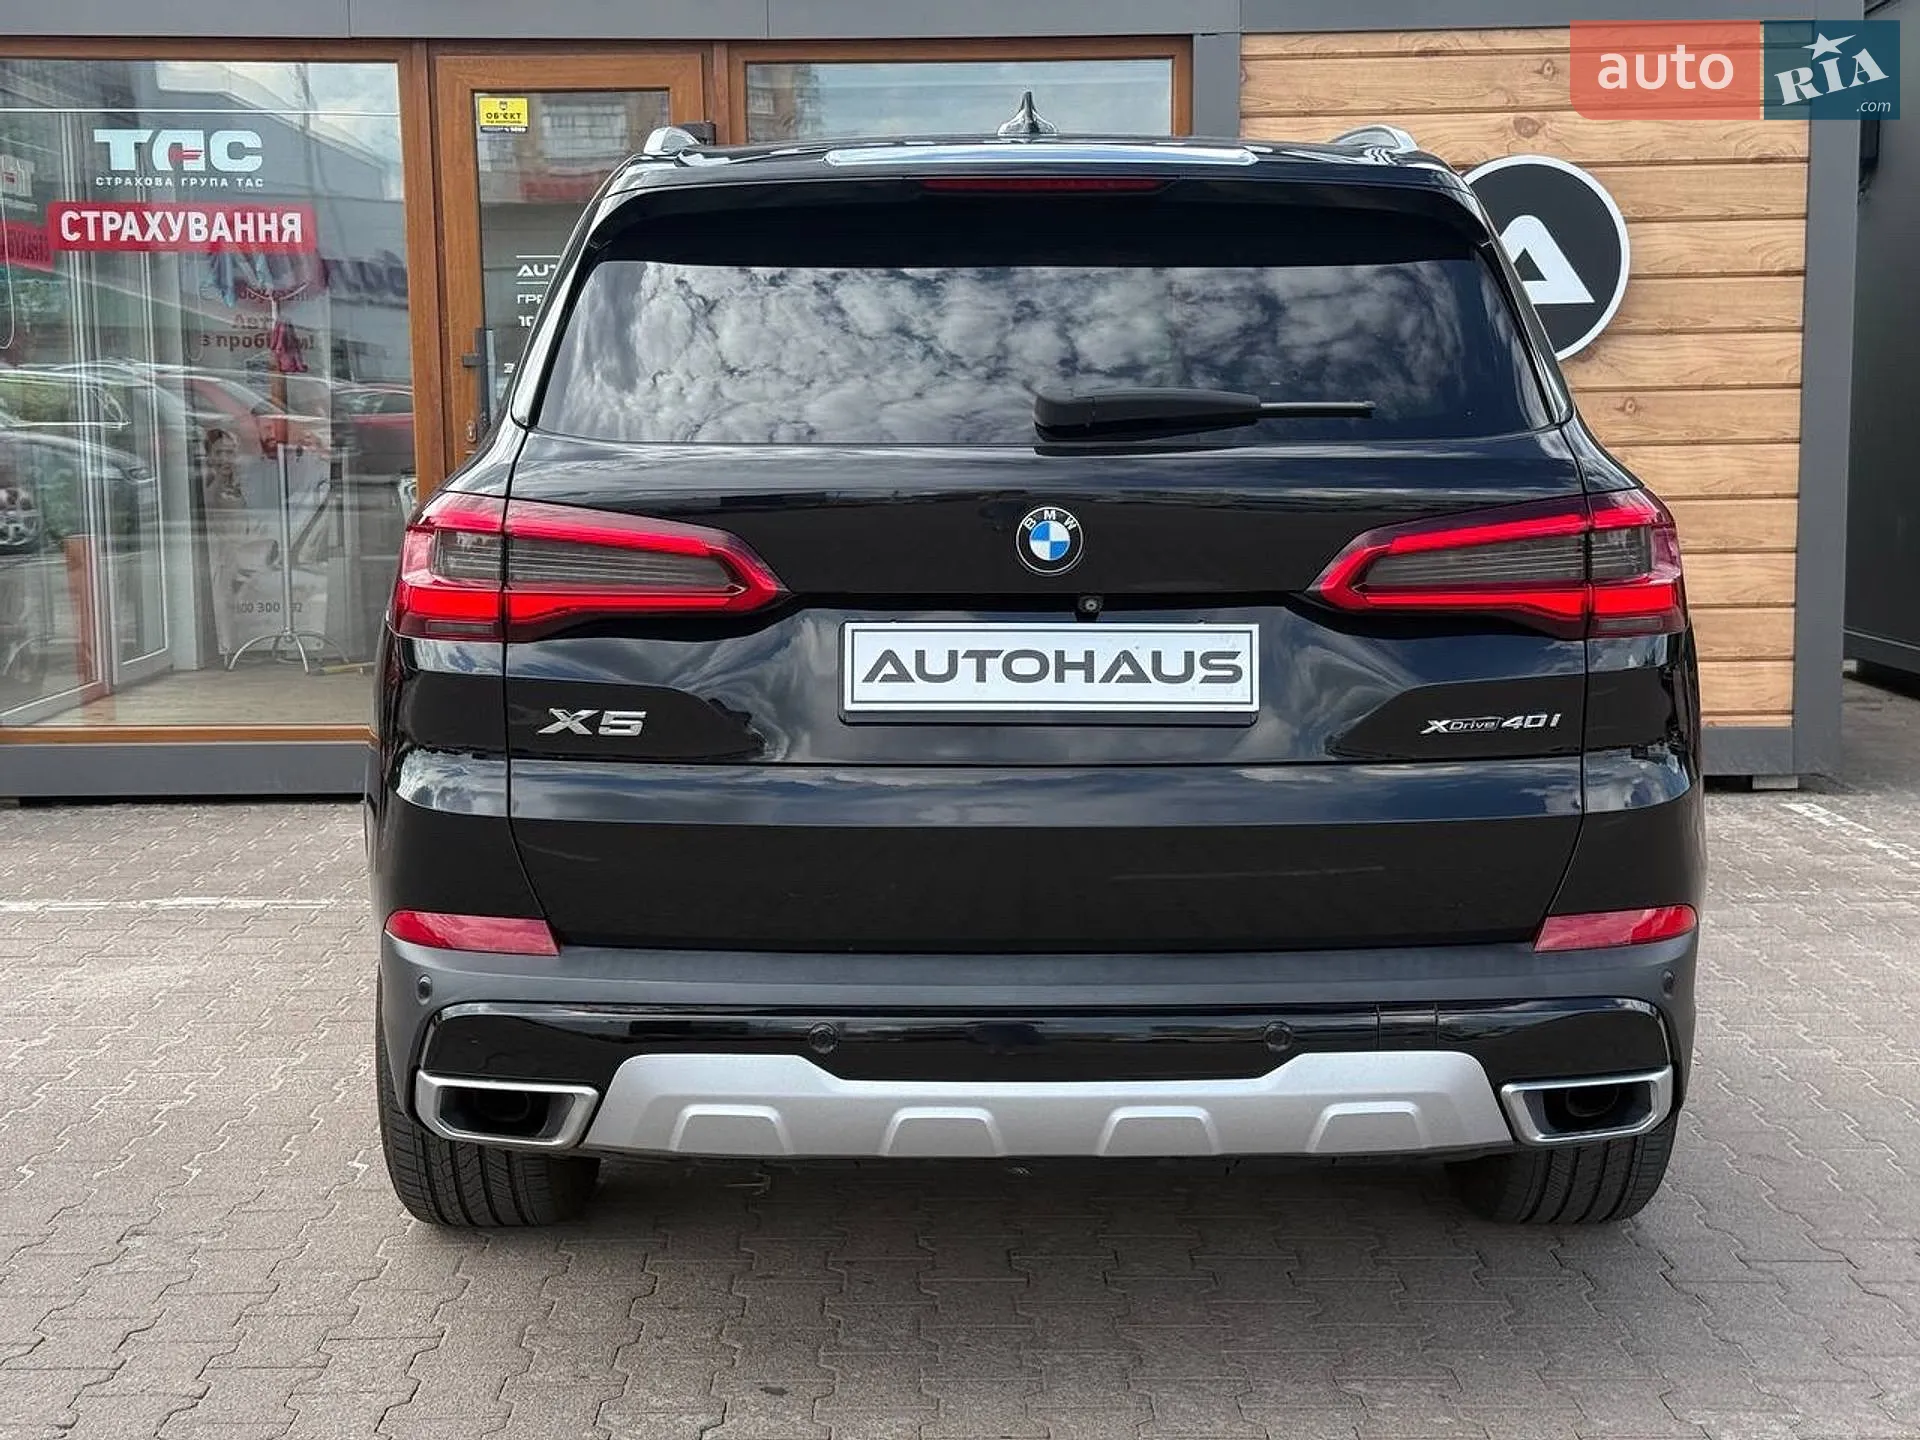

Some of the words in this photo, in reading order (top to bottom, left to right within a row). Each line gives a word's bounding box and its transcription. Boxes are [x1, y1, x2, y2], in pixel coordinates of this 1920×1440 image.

[96, 176, 173, 187] СТРАХОВА
[181, 176, 229, 187] ГРУПА
[236, 177, 264, 187] ТАС
[60, 210, 303, 243] СТРАХУВАННЯ
[1022, 509, 1077, 531] BMW
[861, 648, 1244, 685] AUTOHAUS
[536, 707, 647, 737] X5
